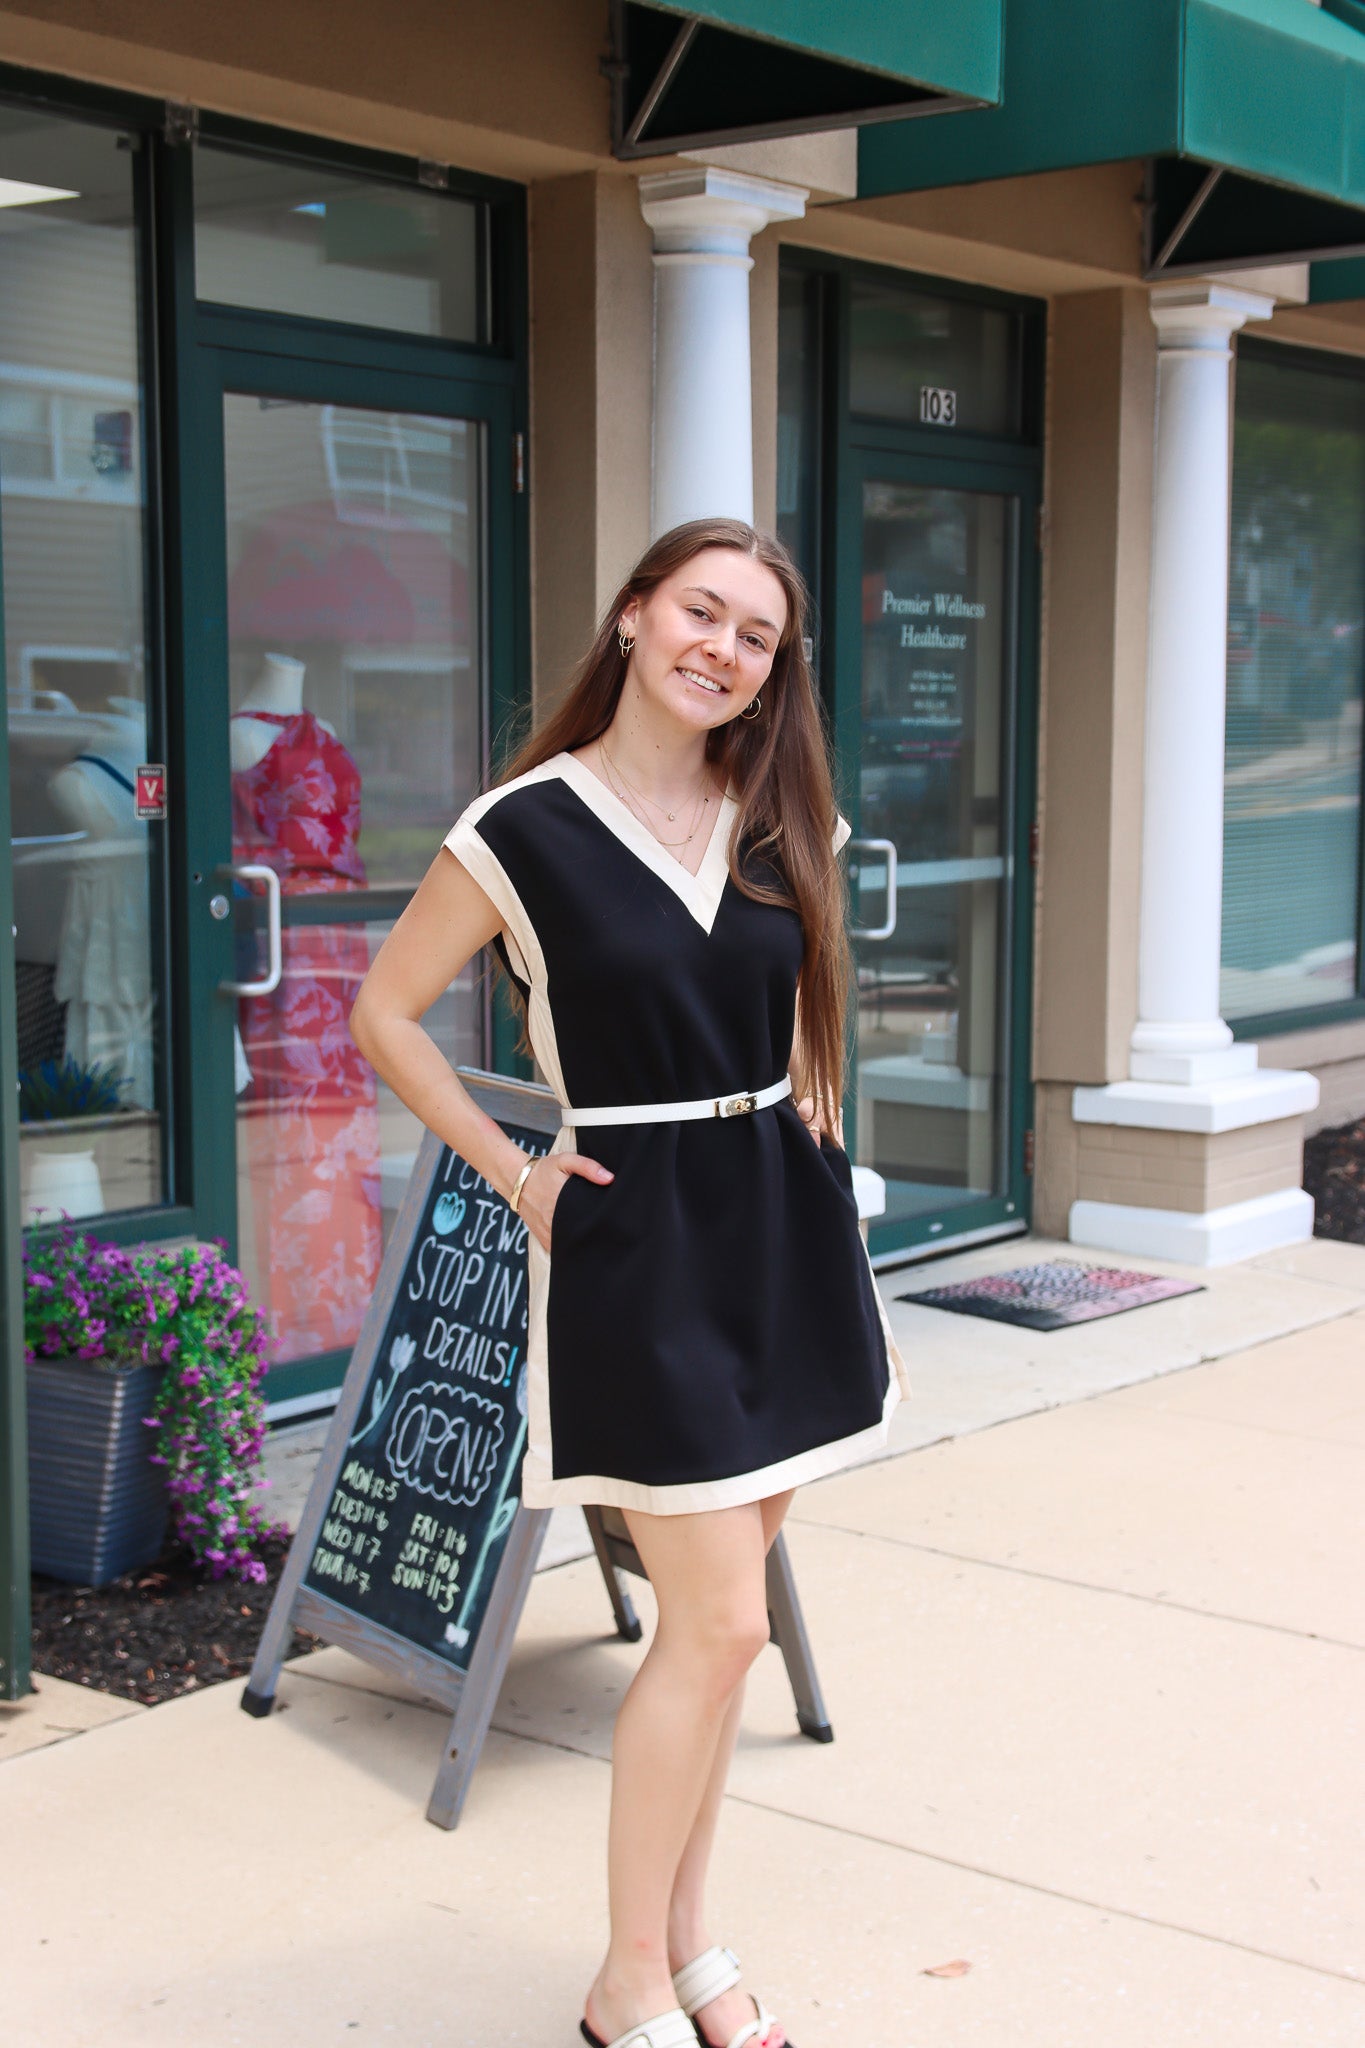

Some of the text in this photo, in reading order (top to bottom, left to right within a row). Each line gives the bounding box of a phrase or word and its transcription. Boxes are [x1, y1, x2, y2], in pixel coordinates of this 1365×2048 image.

[923, 389, 953, 421] 103
[882, 589, 987, 618] Premier Wellness
[901, 624, 967, 649] Healthcare
[408, 1236, 485, 1311] STOP
[479, 1262, 523, 1330] IN
[423, 1316, 519, 1387] DETAILS!
[396, 1403, 492, 1490] OPEN!
